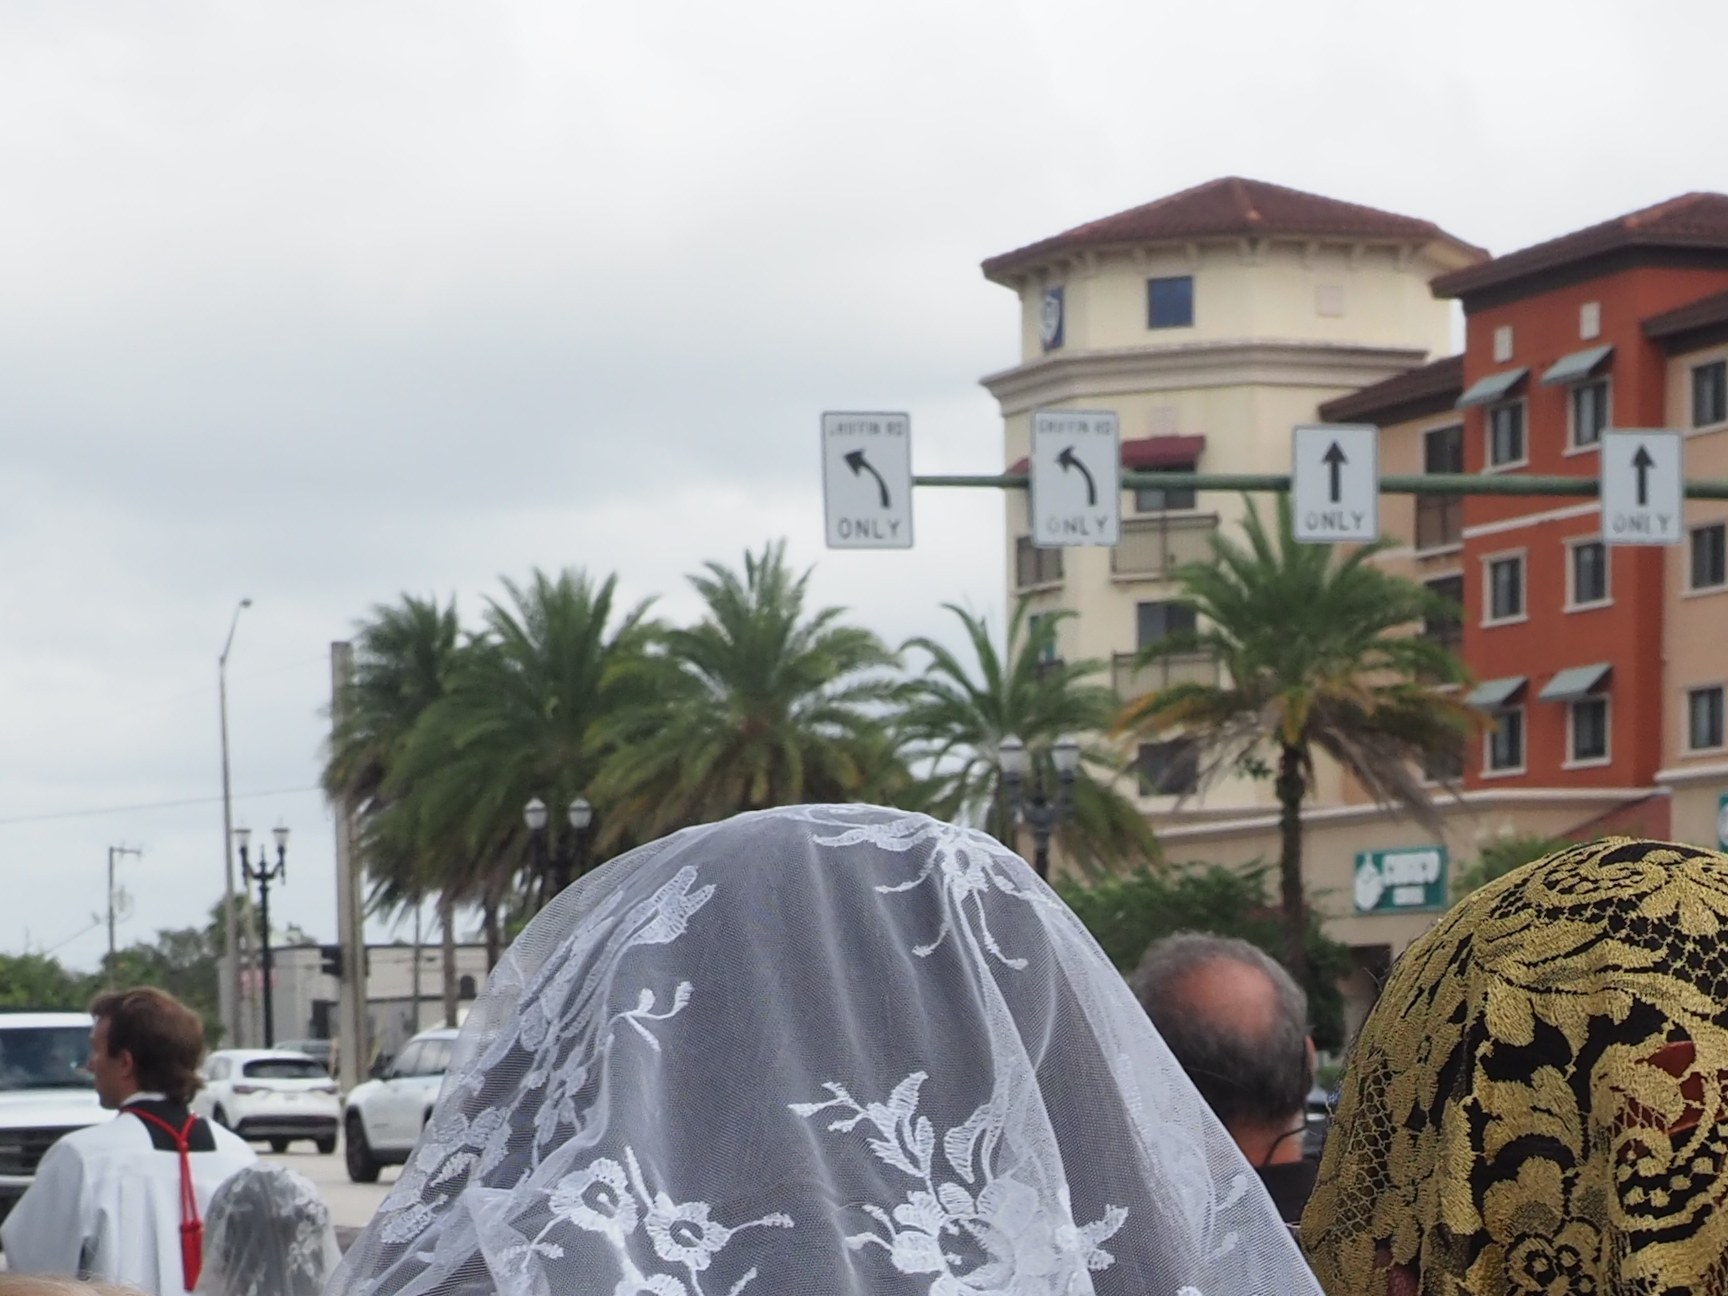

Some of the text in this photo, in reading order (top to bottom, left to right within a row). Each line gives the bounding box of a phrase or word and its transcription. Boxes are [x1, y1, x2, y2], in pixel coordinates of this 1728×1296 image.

[837, 517, 901, 540] ONLY
[1045, 516, 1109, 537] ONLY
[1305, 511, 1367, 533] ONLY
[1612, 513, 1673, 535] ONLY
